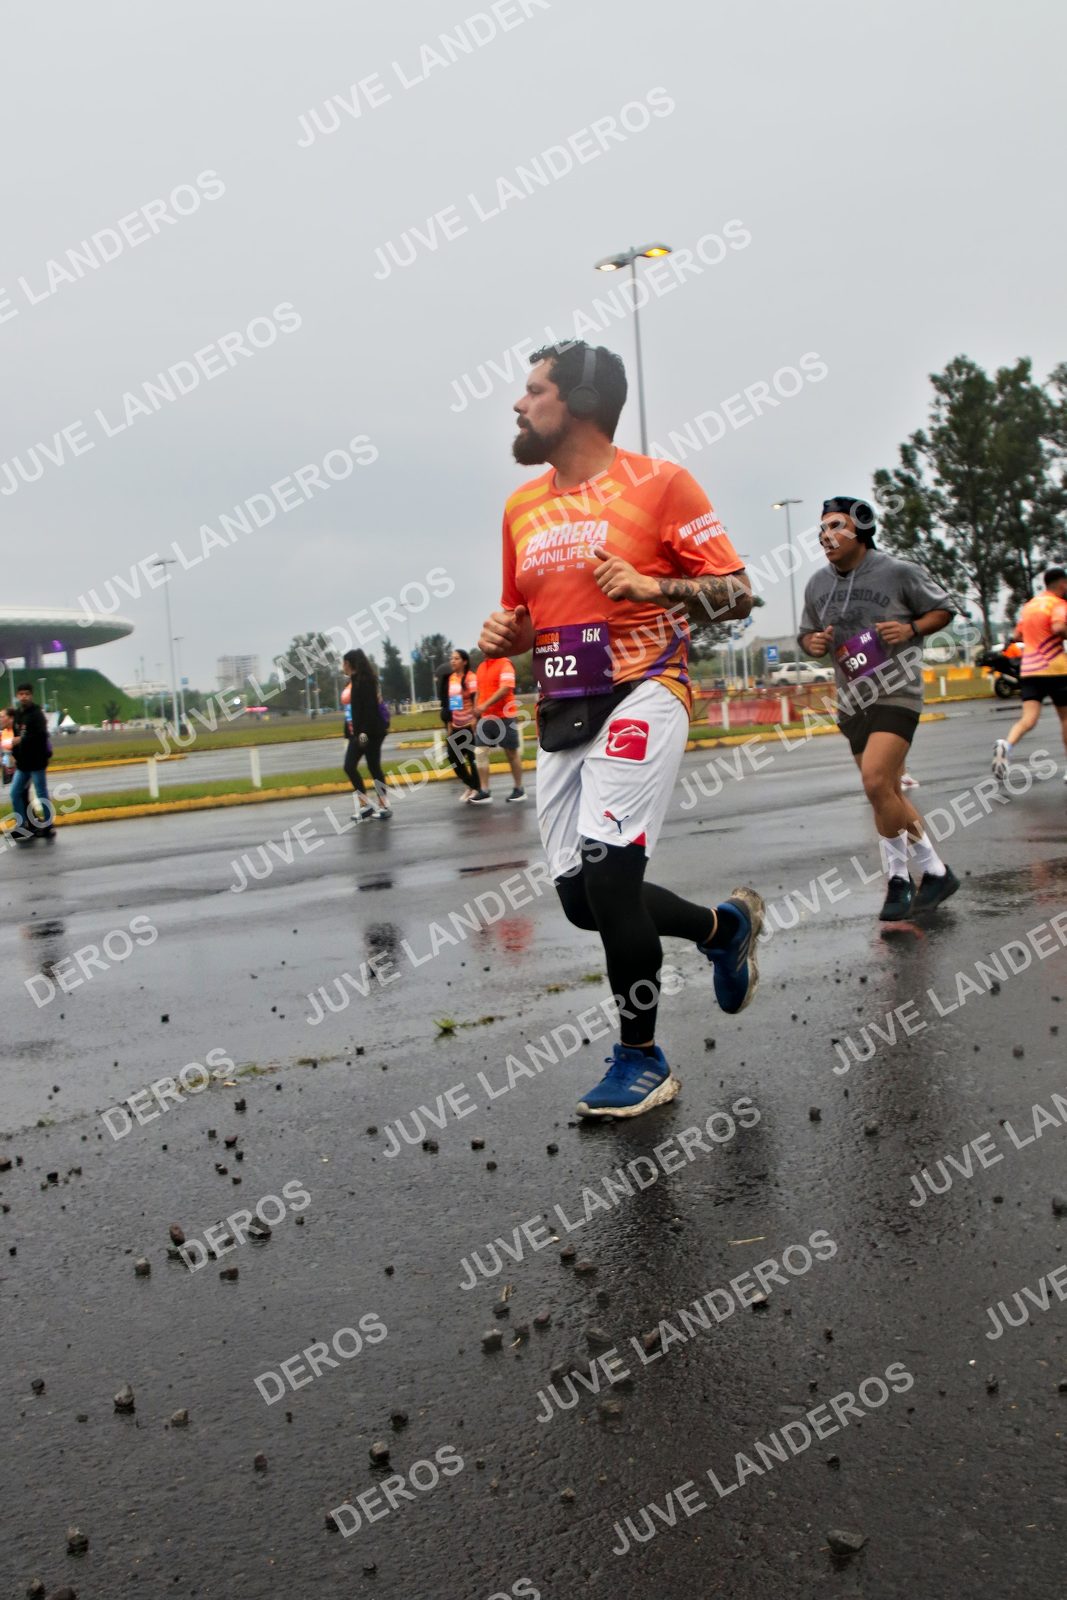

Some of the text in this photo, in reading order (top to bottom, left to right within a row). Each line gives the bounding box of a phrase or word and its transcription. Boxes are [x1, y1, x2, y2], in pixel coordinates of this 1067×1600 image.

[522, 545, 585, 571] OMNILIFE
[582, 628, 601, 643] 15K
[545, 655, 578, 678] 622
